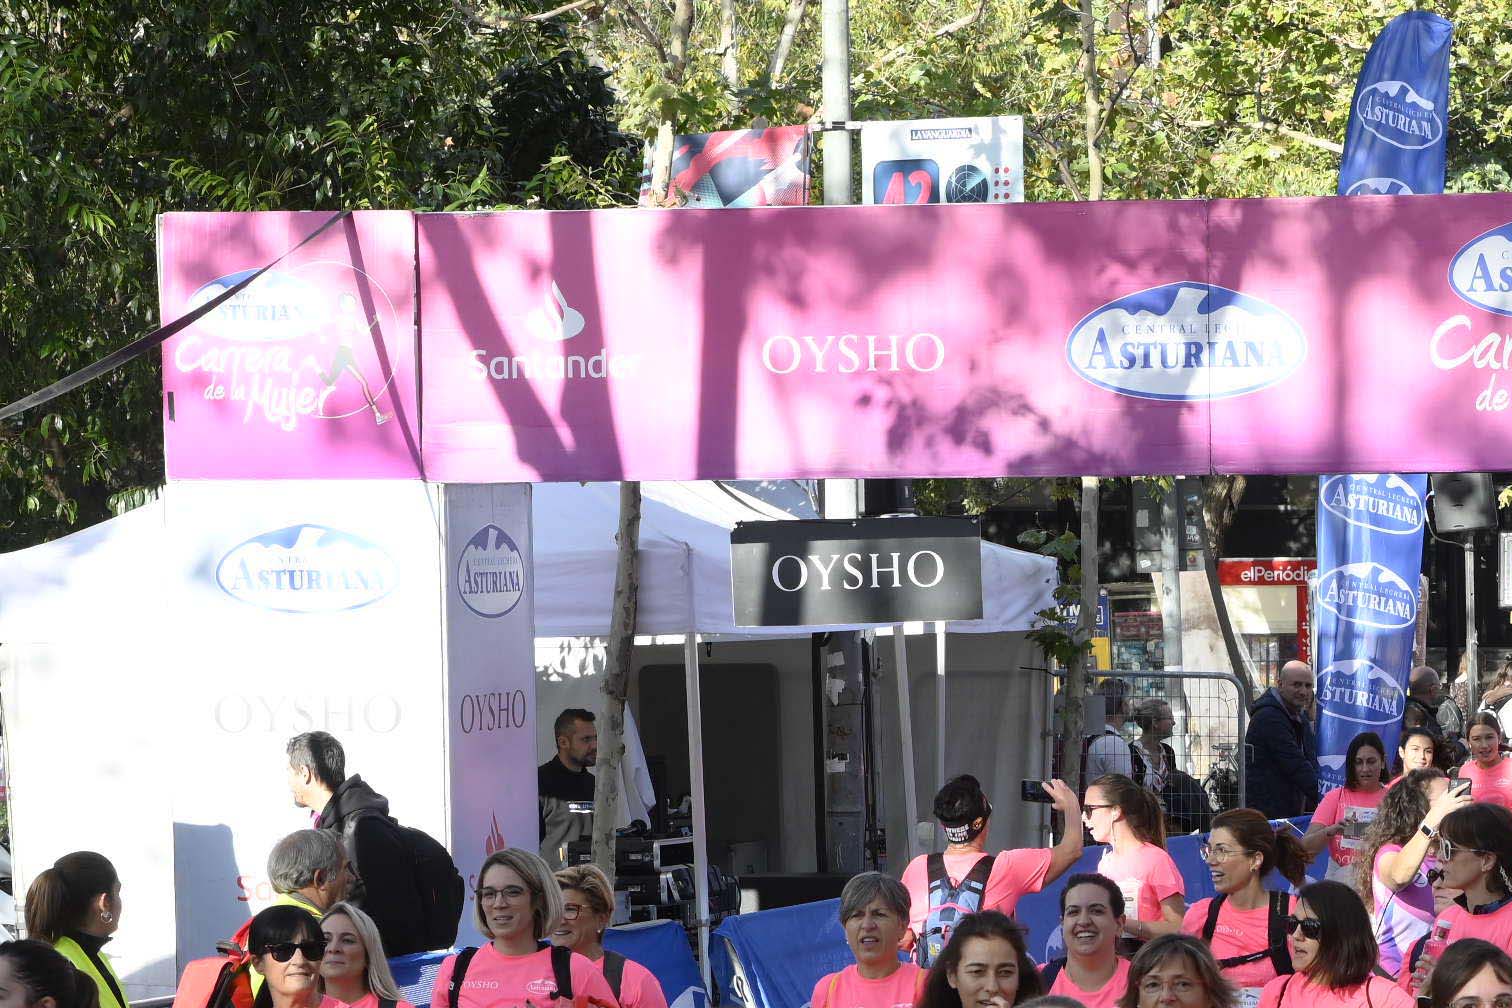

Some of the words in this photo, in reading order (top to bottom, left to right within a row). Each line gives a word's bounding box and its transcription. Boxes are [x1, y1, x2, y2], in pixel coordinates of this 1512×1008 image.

[1084, 328, 1288, 371] ASTURIANA
[1122, 323, 1199, 335] CENTRAL
[174, 335, 292, 373] Carrera
[469, 349, 639, 380] Santander
[762, 332, 945, 374] OYSHO
[1476, 376, 1509, 412] de
[1330, 483, 1418, 526] ASTURIANA
[462, 563, 521, 596] ASTURIANA
[771, 550, 946, 594] OYSHO
[1325, 577, 1411, 620] ASTURIANA
[213, 694, 403, 736] OYSHO
[460, 690, 527, 734] OYSHO
[463, 980, 499, 990] OYSHO
